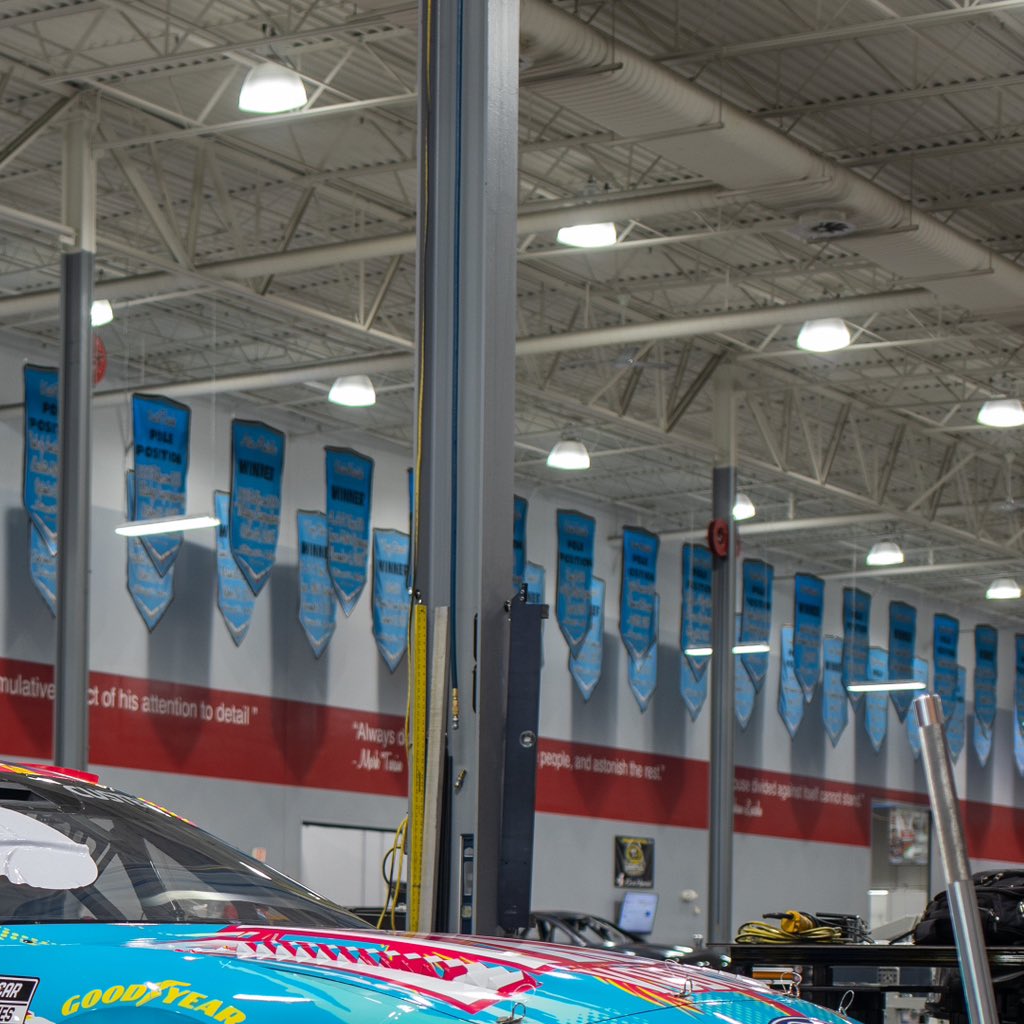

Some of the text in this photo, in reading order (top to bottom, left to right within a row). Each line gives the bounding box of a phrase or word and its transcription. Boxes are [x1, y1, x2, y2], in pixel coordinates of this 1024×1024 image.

[102, 686, 116, 708] of
[119, 689, 139, 712] his
[142, 694, 197, 718] attention
[200, 701, 213, 721] to
